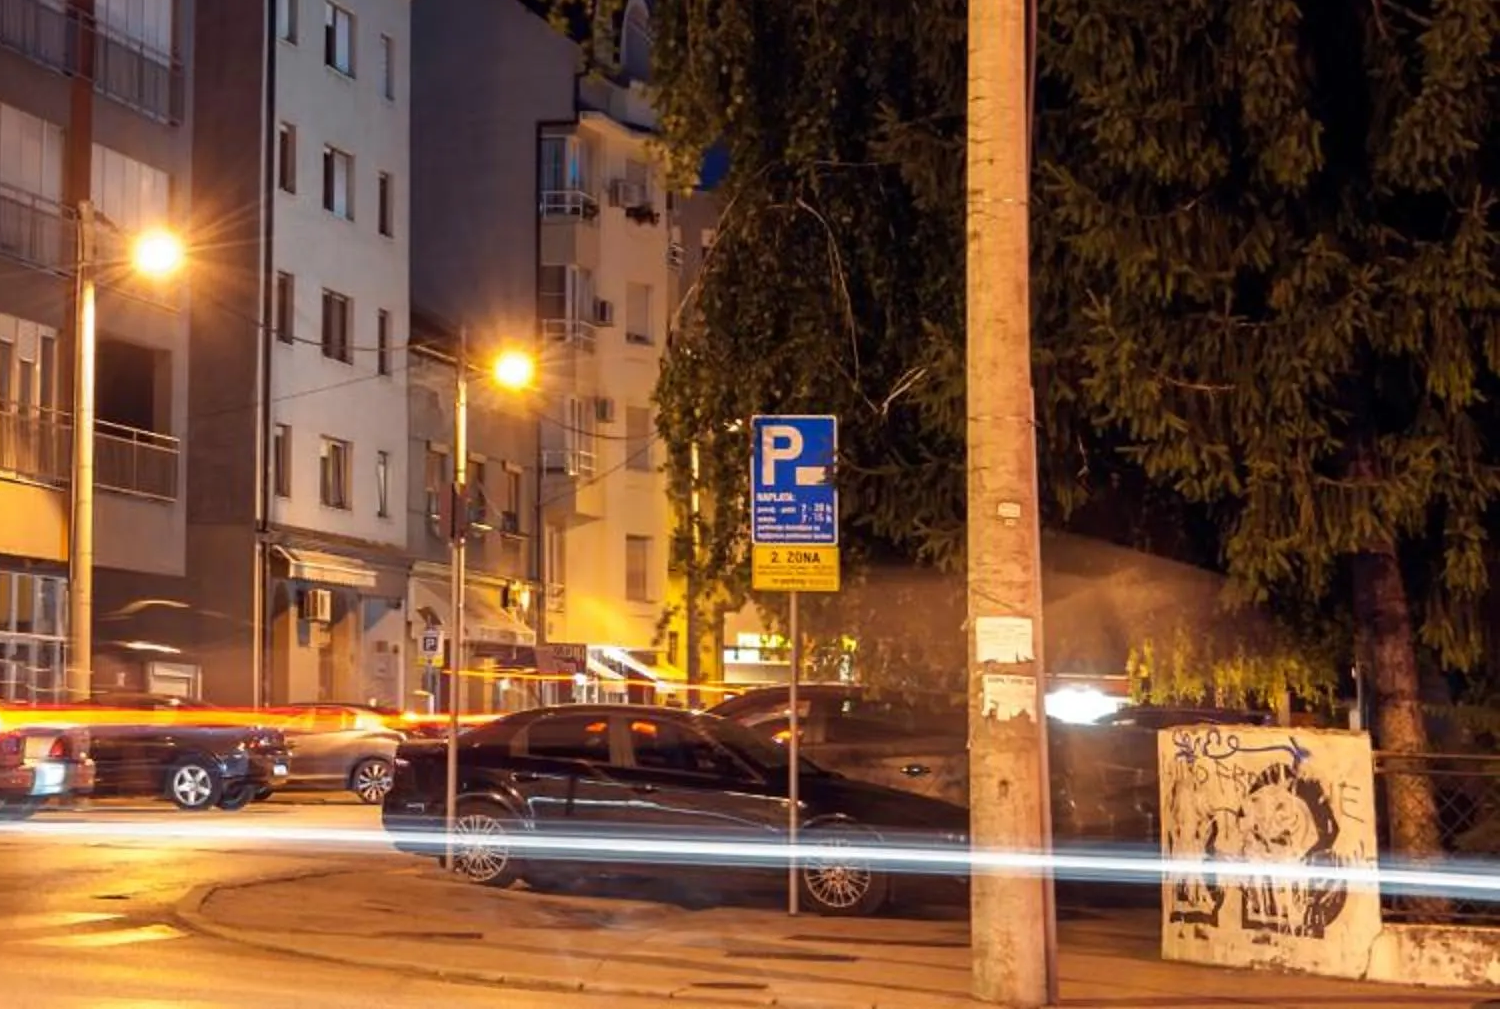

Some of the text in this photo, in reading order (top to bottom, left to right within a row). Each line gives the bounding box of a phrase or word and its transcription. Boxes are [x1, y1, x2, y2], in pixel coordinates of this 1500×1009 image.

[761, 425, 804, 486] P
[786, 551, 821, 564] ZONA
[425, 638, 435, 650] P
